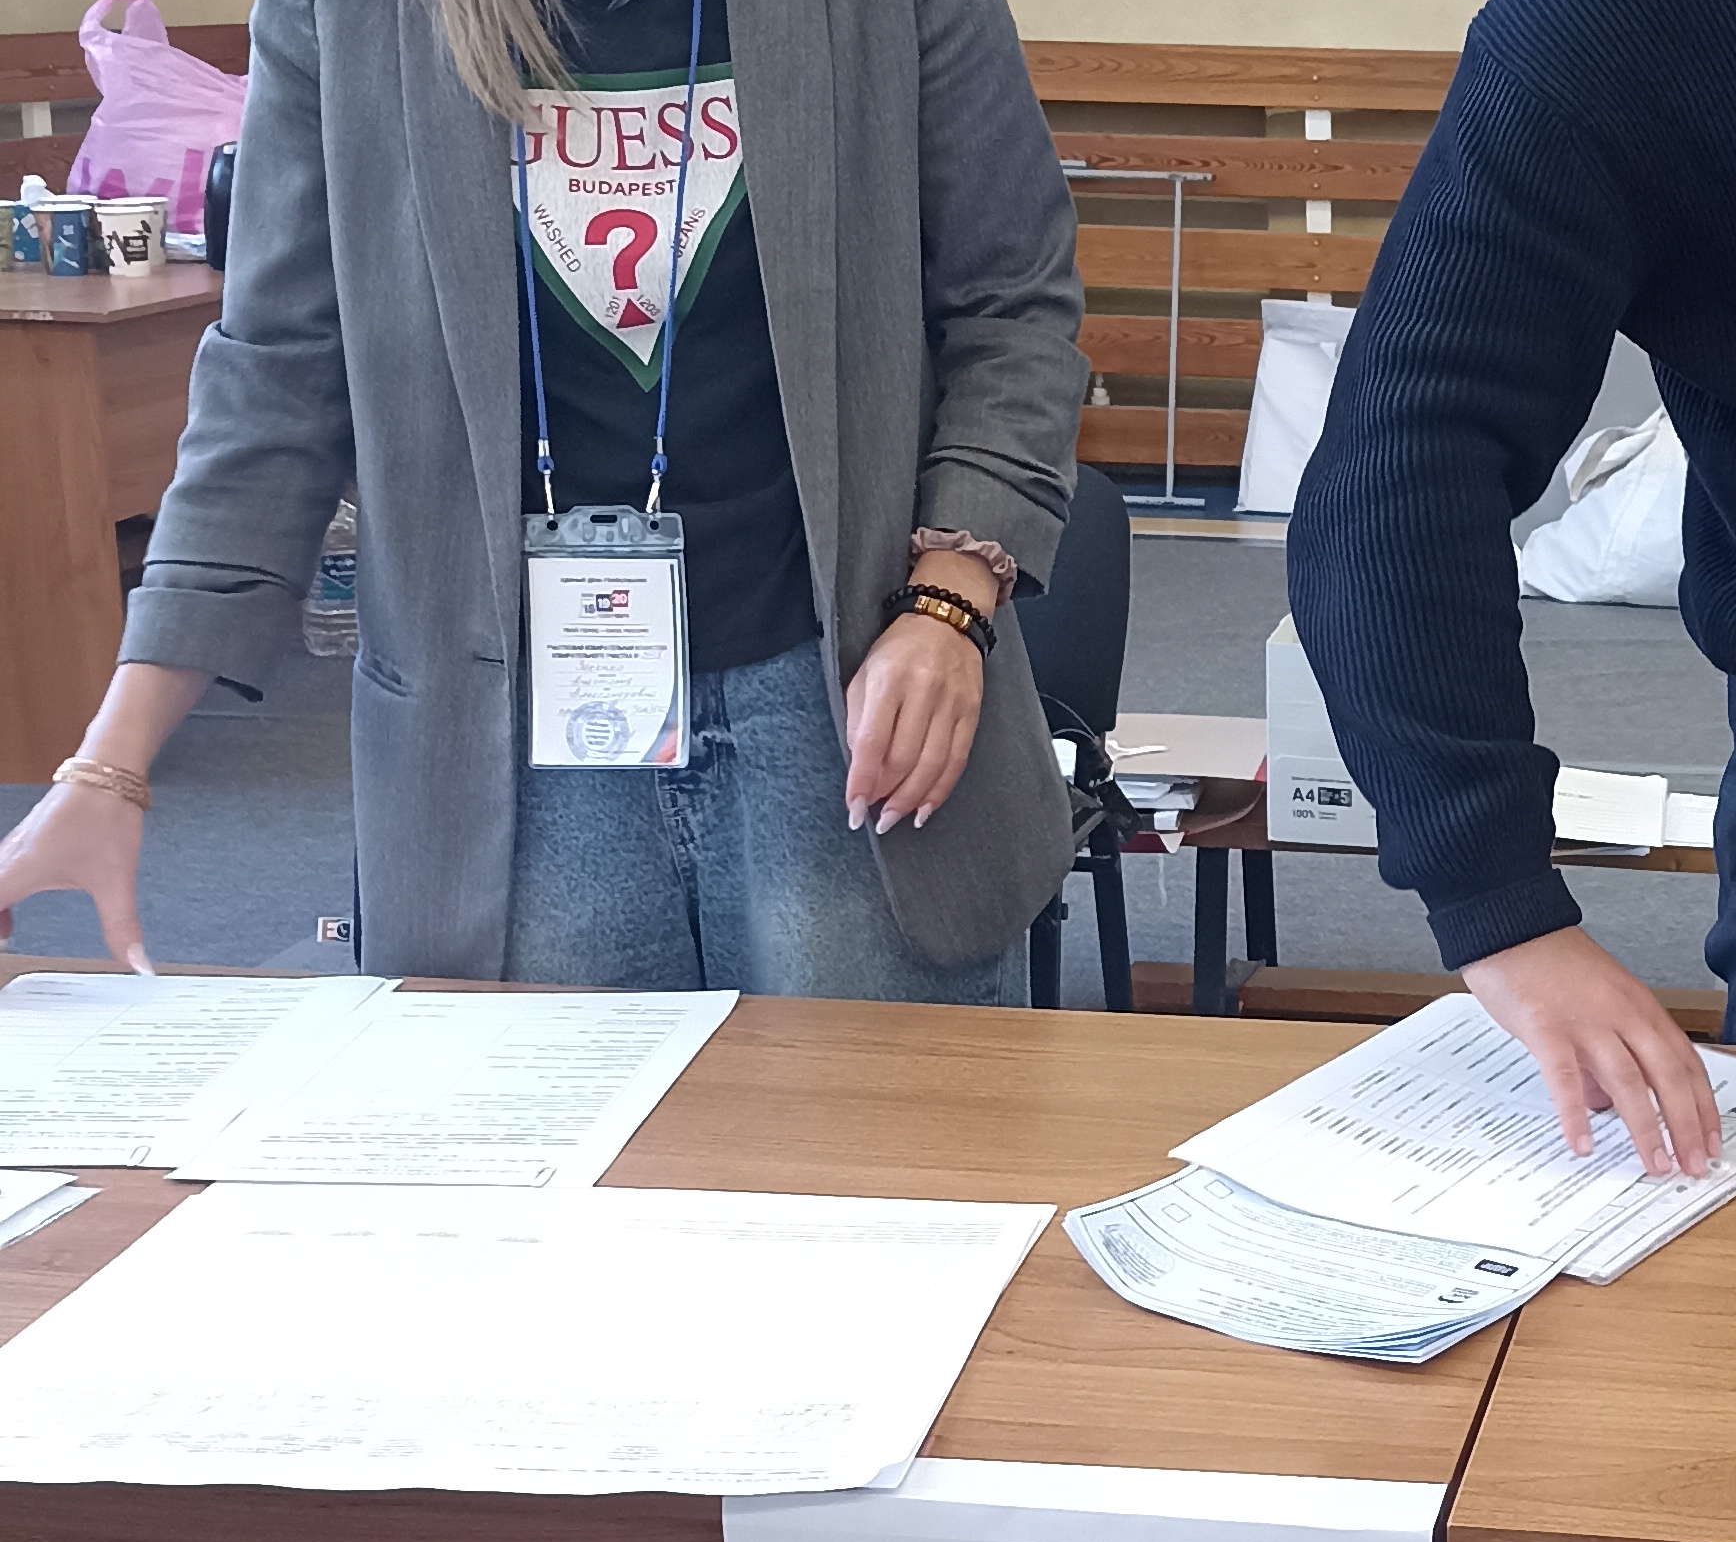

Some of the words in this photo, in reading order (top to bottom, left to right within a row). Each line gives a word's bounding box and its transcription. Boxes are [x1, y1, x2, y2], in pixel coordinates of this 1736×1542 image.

[567, 178, 677, 197] BUDAPEST
[534, 203, 582, 274] WASHED
[1292, 787, 1316, 803] A4
